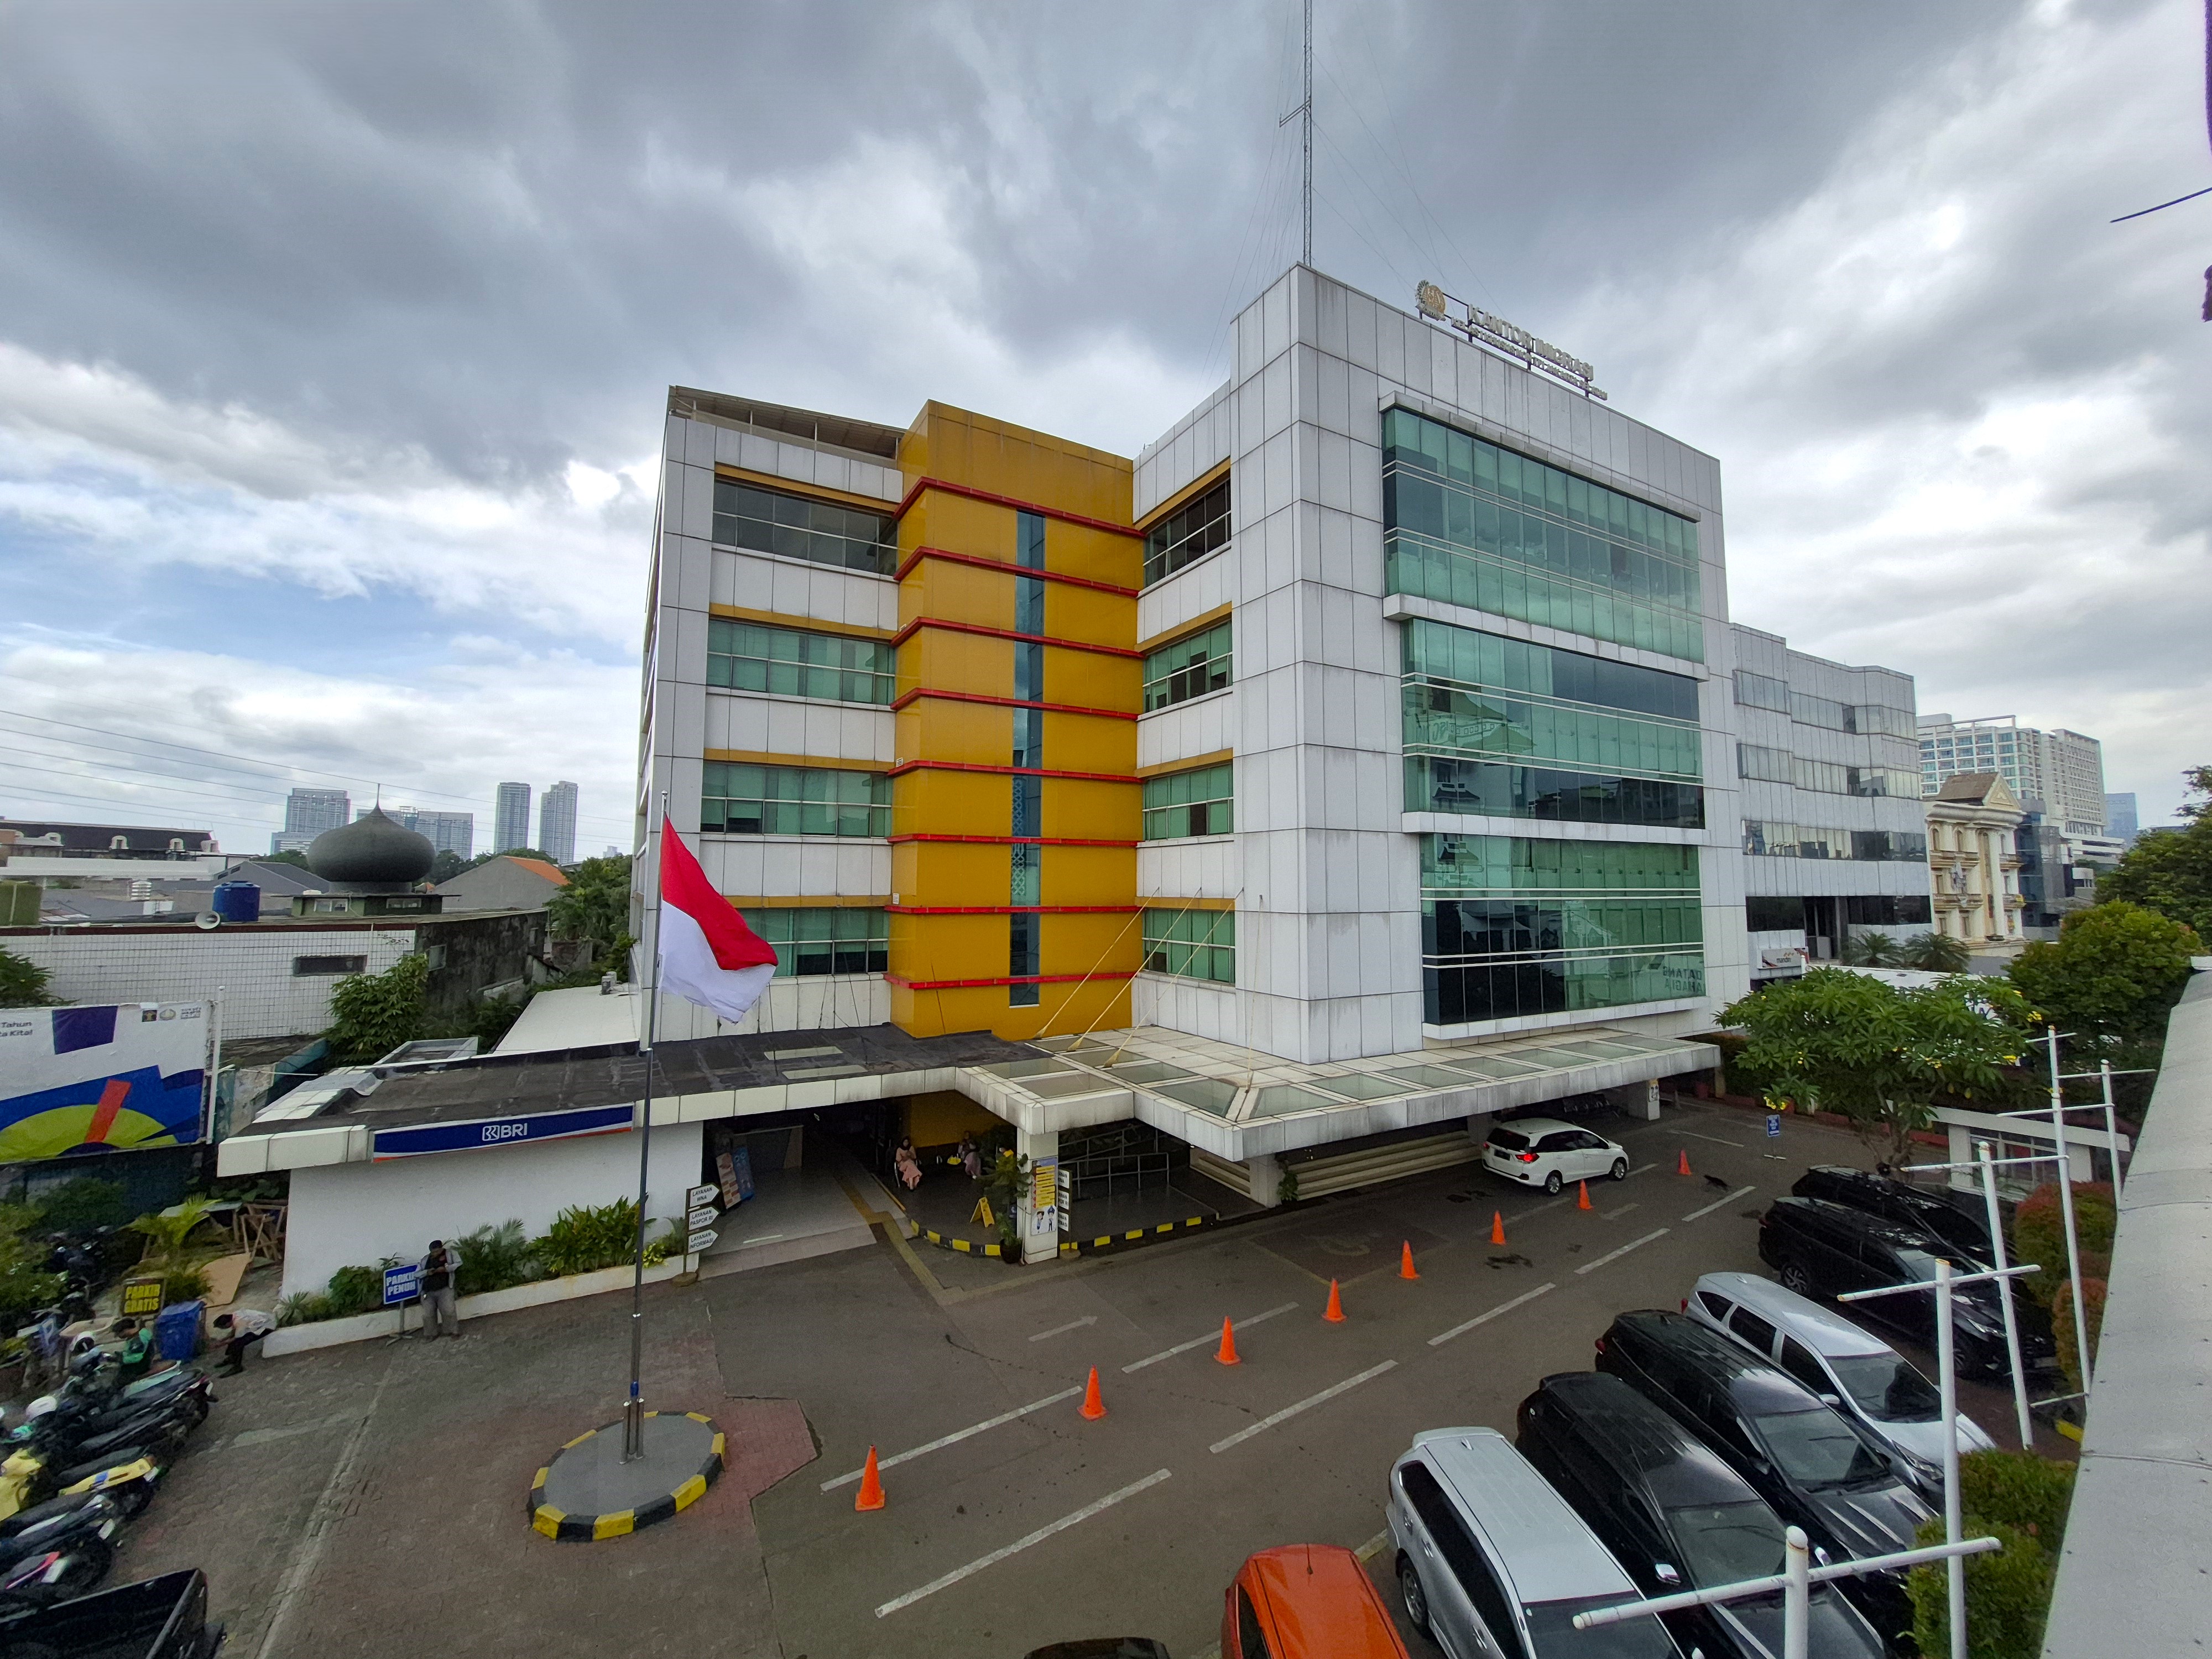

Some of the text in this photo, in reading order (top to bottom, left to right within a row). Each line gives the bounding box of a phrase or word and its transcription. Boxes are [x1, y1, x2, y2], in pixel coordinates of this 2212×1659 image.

[1468, 304, 1594, 382] KANTOR IMIGRASI
[500, 1123, 528, 1138] BRI
[692, 1187, 713, 1197] LAYANAN
[692, 1209, 712, 1219] LAYANAN
[690, 1217, 707, 1226] PASPOR
[689, 1238, 713, 1249] INFORMASI
[691, 1232, 711, 1243] LAYANAN
[125, 1284, 160, 1299] PARKIR
[388, 1281, 416, 1296] PENUH
[124, 1298, 159, 1313] GRATIS
